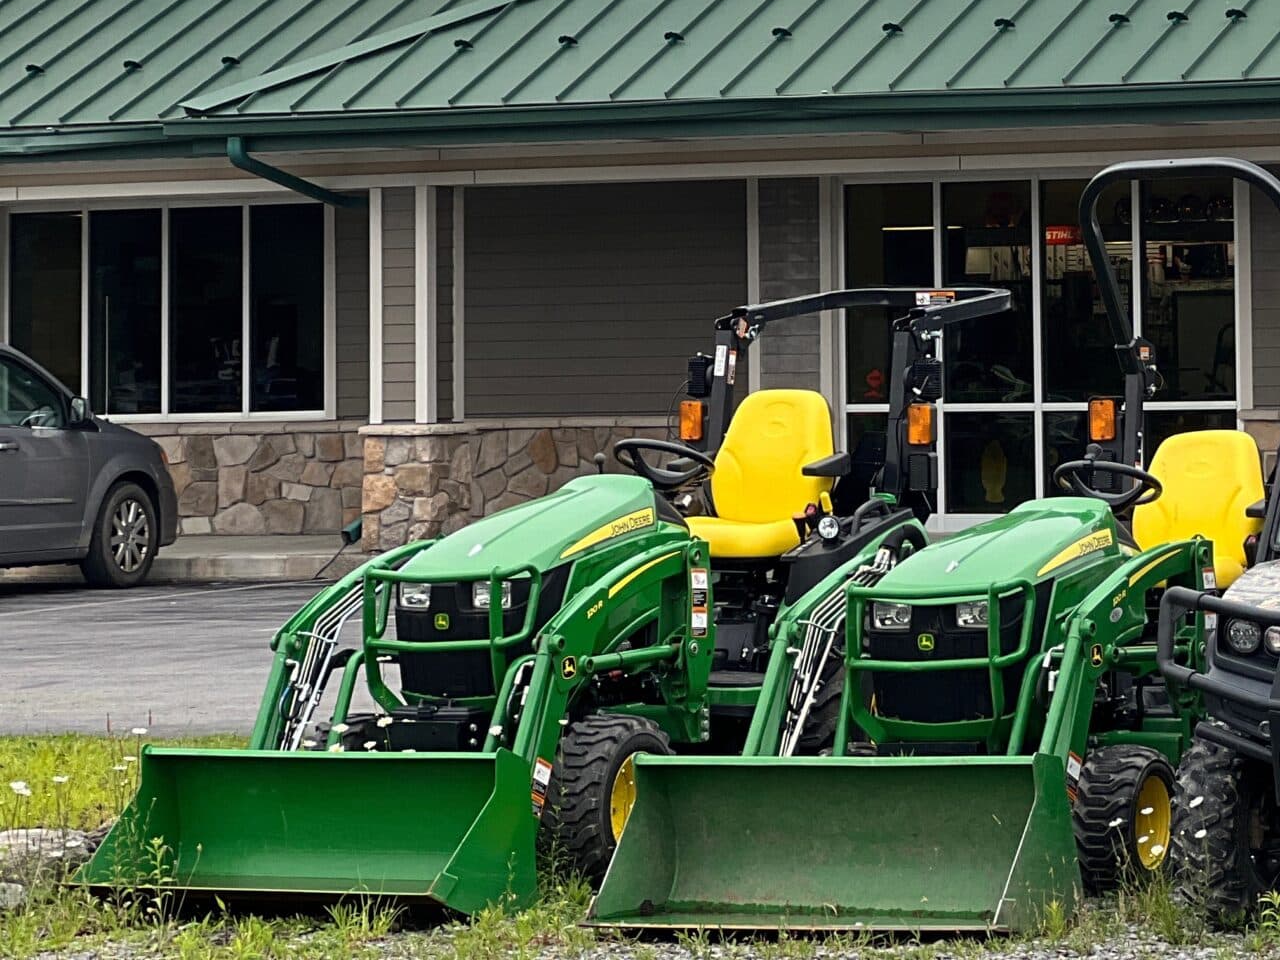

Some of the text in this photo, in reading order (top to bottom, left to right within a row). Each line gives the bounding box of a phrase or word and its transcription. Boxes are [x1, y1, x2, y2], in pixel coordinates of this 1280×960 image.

[1045, 230, 1074, 240] STIHL
[610, 514, 651, 536] JOHN DEERE
